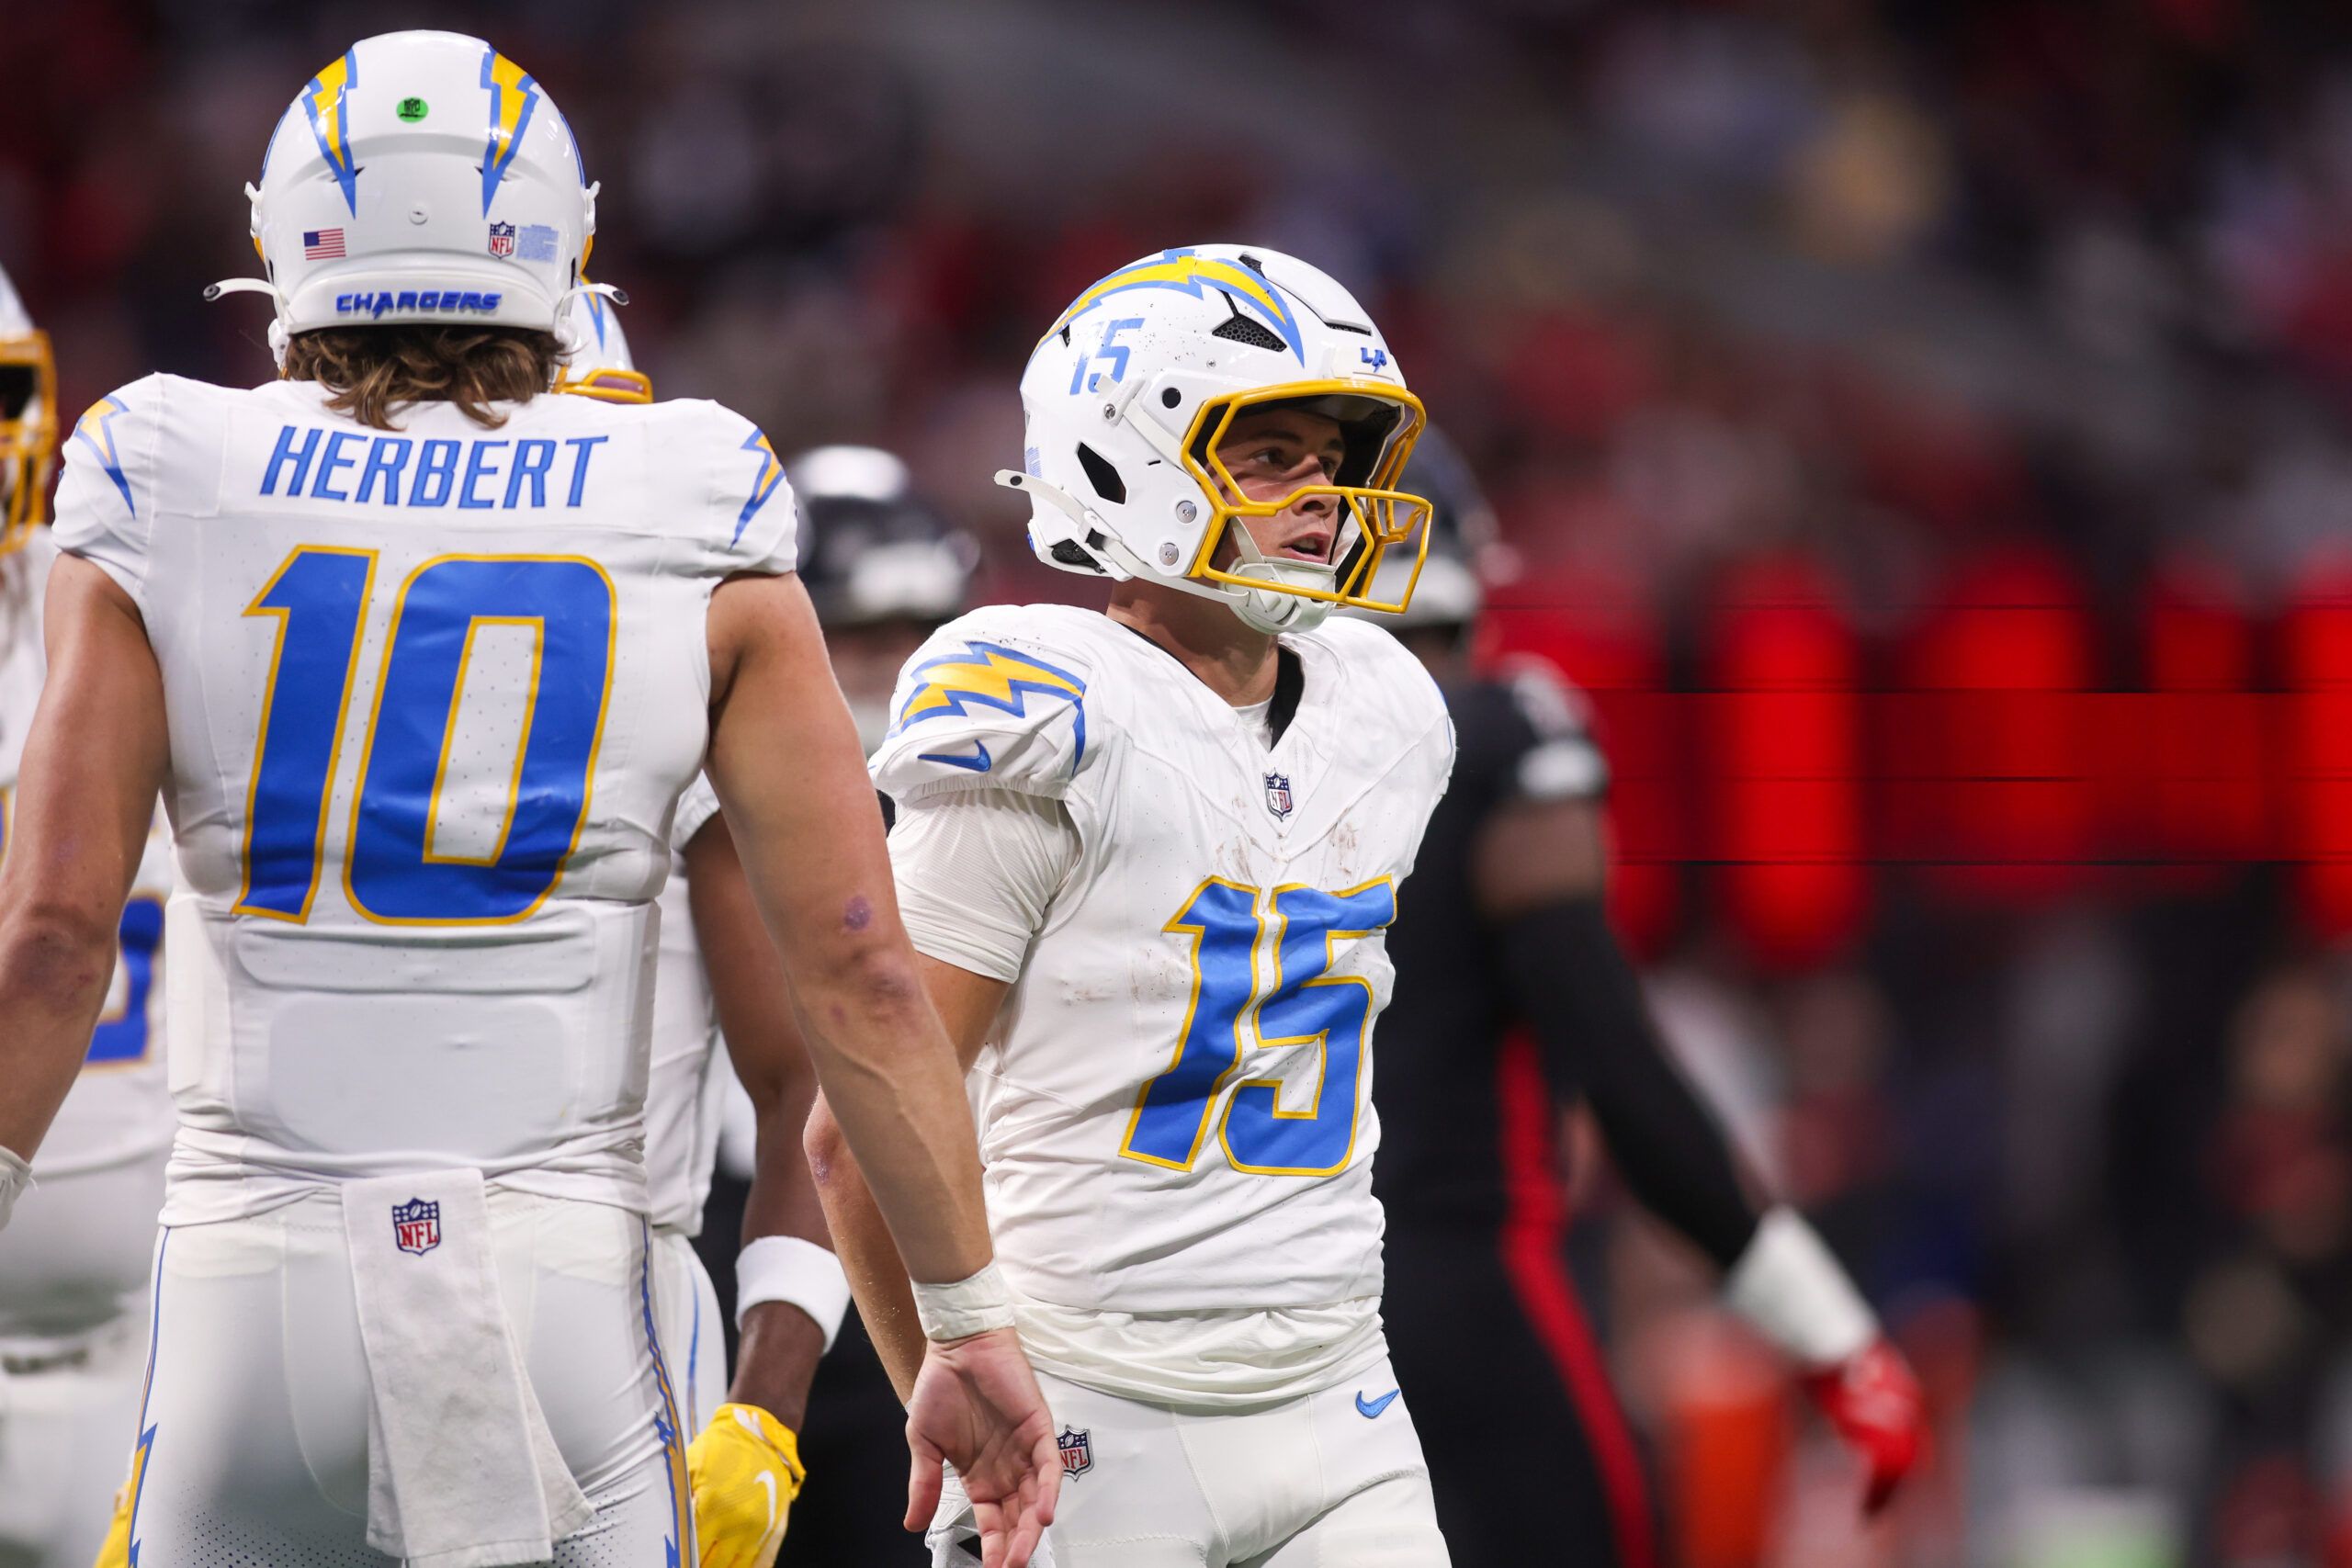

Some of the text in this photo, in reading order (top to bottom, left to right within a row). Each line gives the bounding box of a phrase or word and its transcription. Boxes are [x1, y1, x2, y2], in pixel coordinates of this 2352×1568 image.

[492, 237, 514, 254] NFL
[336, 290, 503, 320] CHARGERS
[1069, 318, 1145, 396] 15
[1361, 347, 1386, 373] LA
[259, 426, 608, 509] HERBERT
[230, 544, 617, 927] 10
[1270, 791, 1291, 810] NFL
[1118, 874, 1397, 1178] 15
[399, 1221, 438, 1248] NFL
